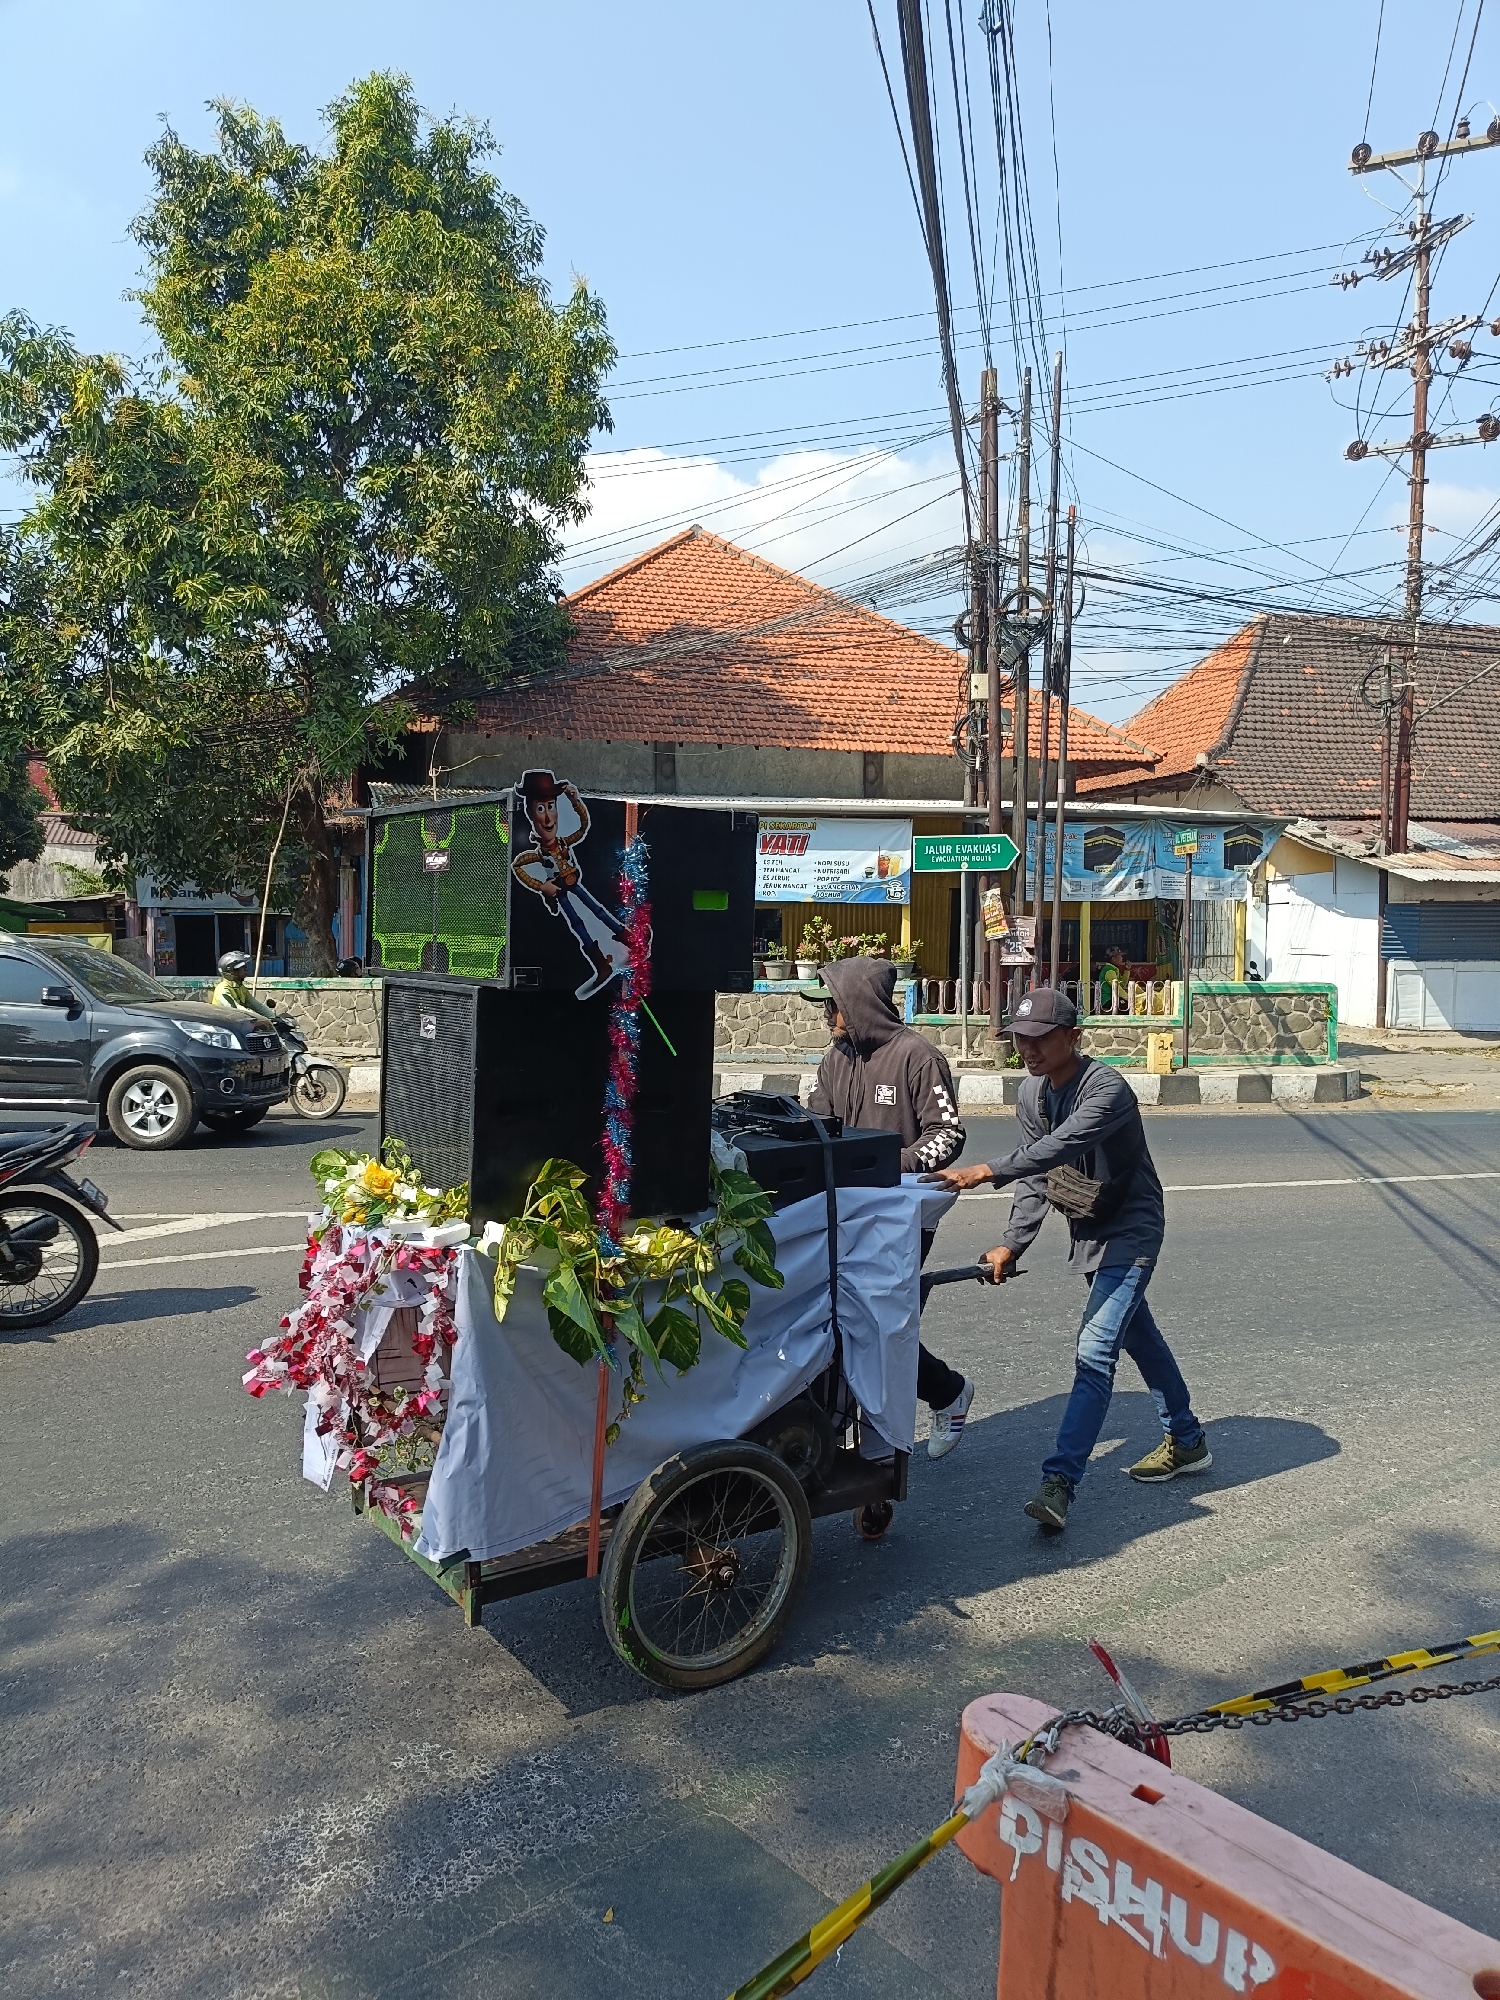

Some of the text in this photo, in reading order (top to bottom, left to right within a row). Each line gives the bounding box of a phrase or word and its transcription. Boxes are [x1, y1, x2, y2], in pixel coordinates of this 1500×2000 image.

[758, 821, 817, 830] PI SEKARTAJI
[760, 833, 809, 855] YATI
[924, 844, 1000, 855] JALUR EVAKUASI
[931, 855, 970, 863] EVACUATION
